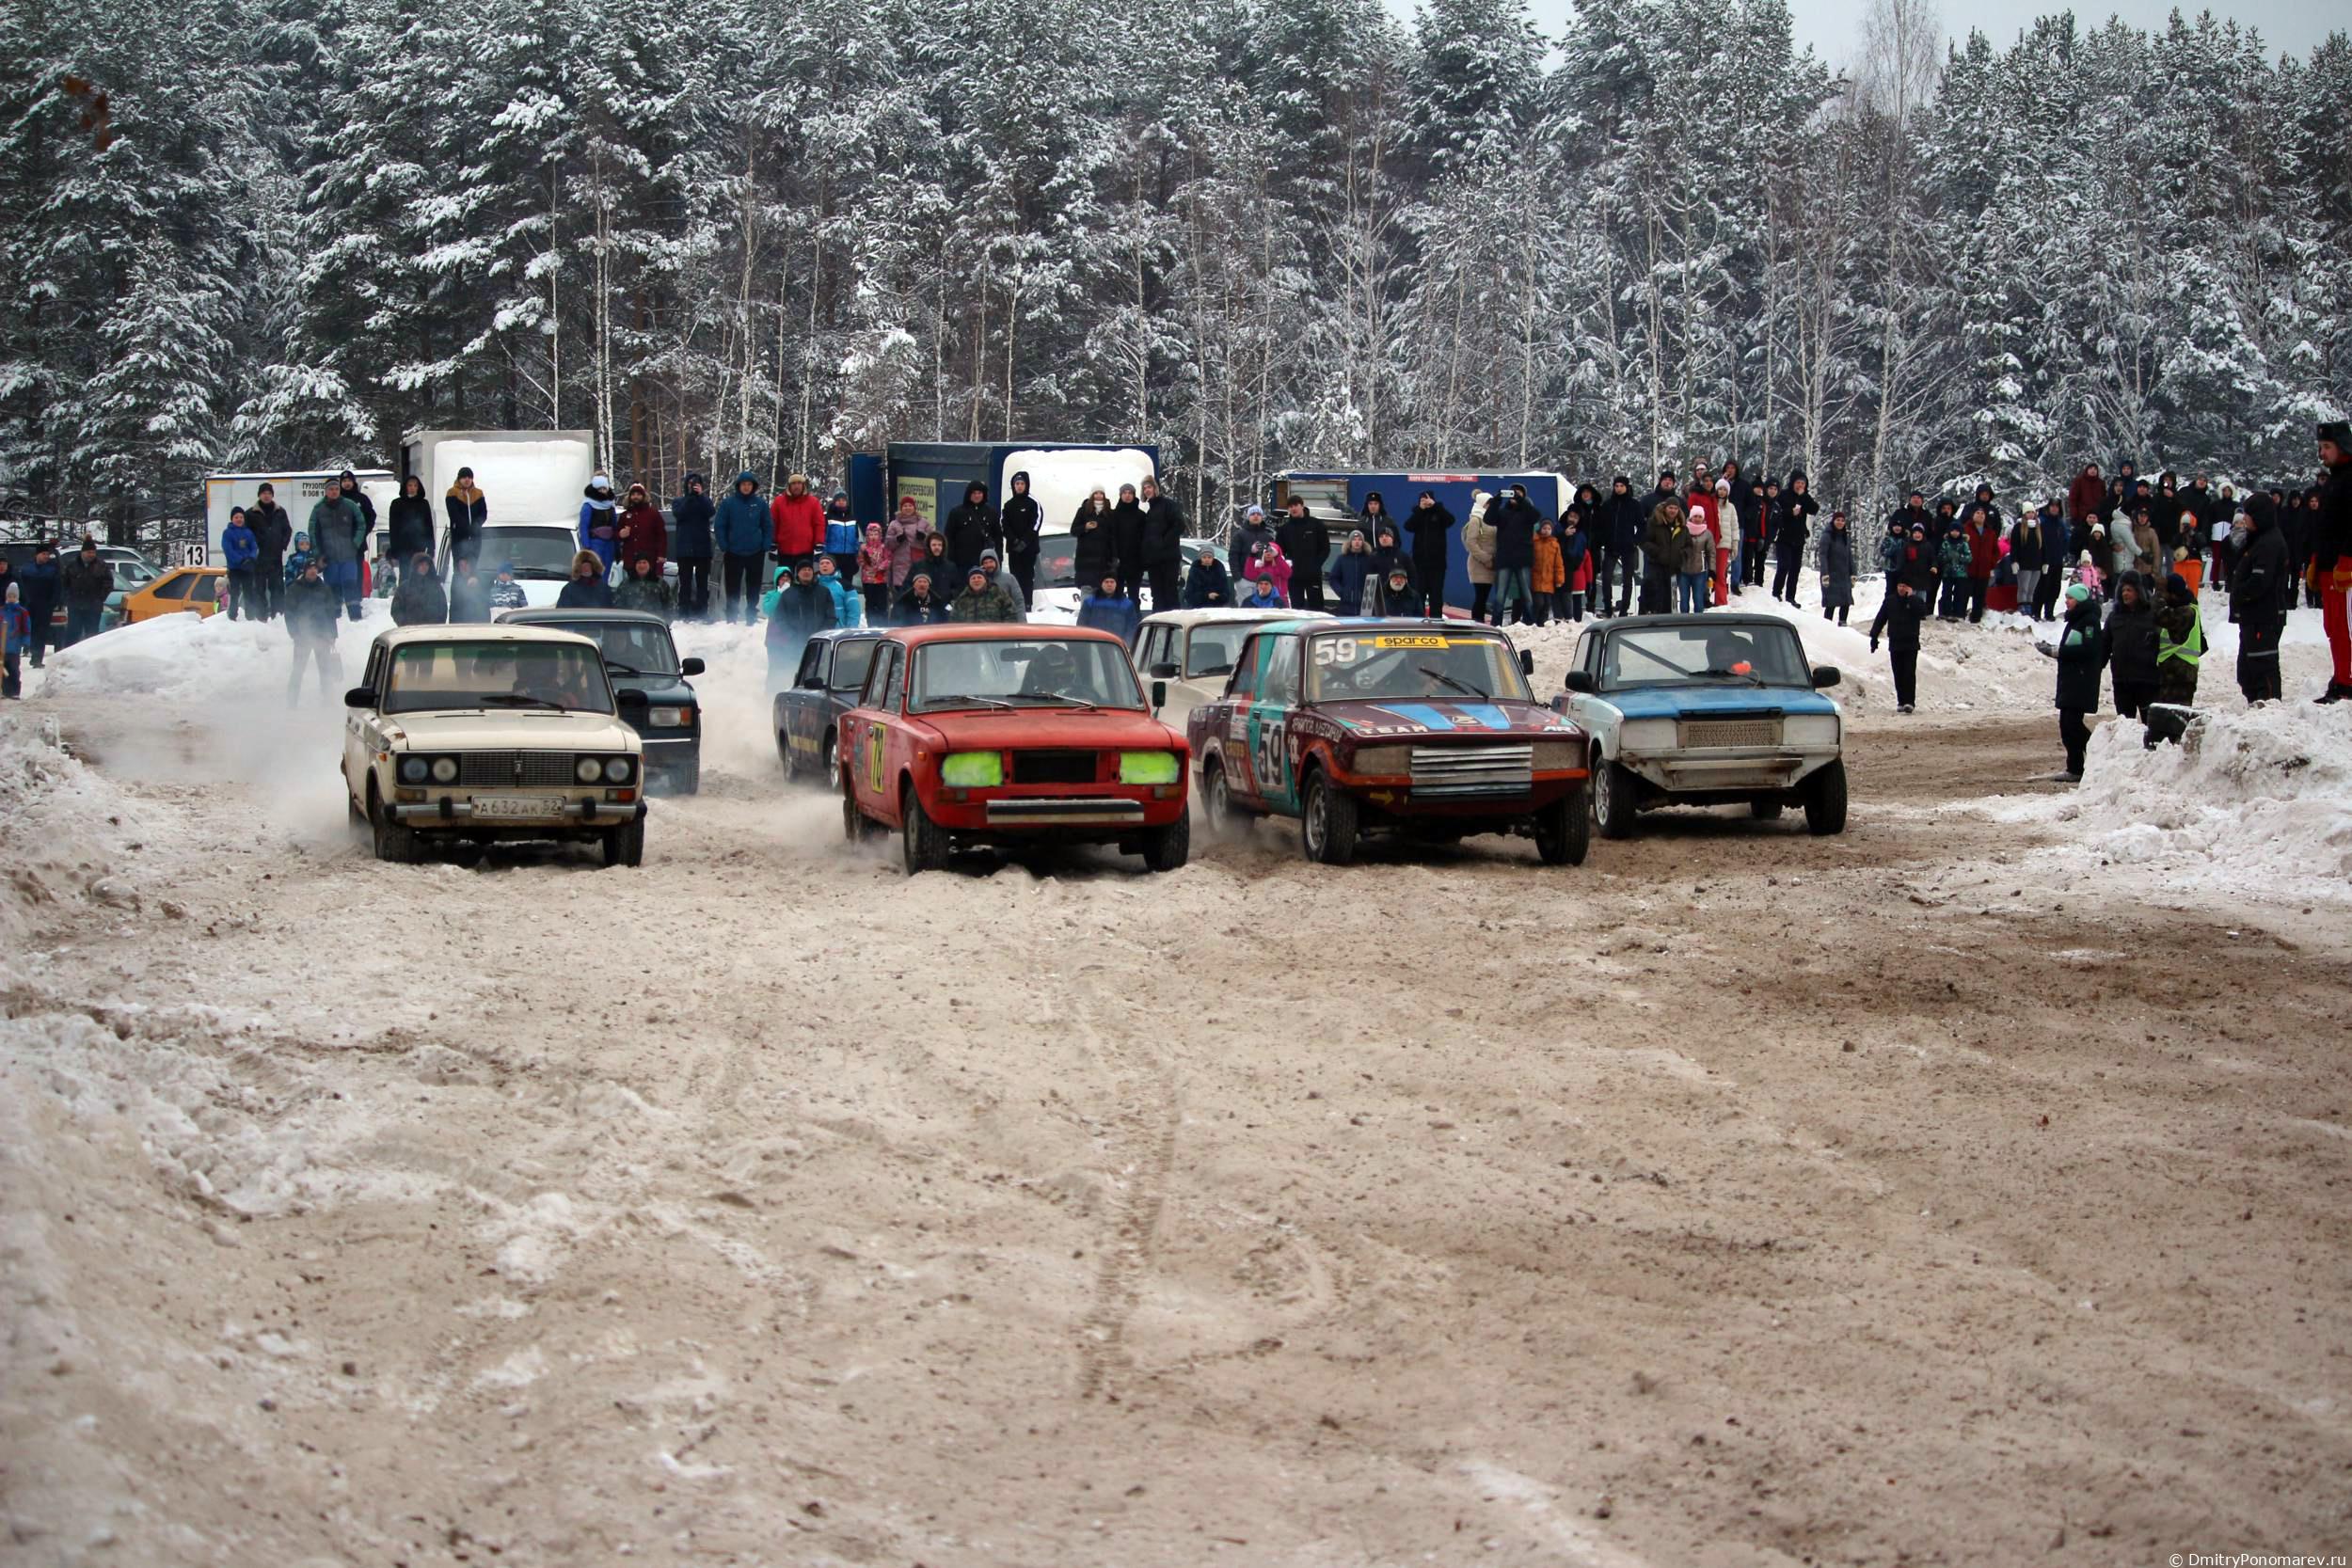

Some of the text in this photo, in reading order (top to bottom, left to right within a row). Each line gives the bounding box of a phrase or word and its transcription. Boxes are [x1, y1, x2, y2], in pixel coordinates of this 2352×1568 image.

[186, 546, 203, 565] 13
[1384, 637, 1438, 646] sparco
[1315, 638, 1357, 665] 59
[1359, 725, 1428, 735] TEAM
[1258, 722, 1282, 785] 59
[542, 800, 558, 815] 52
